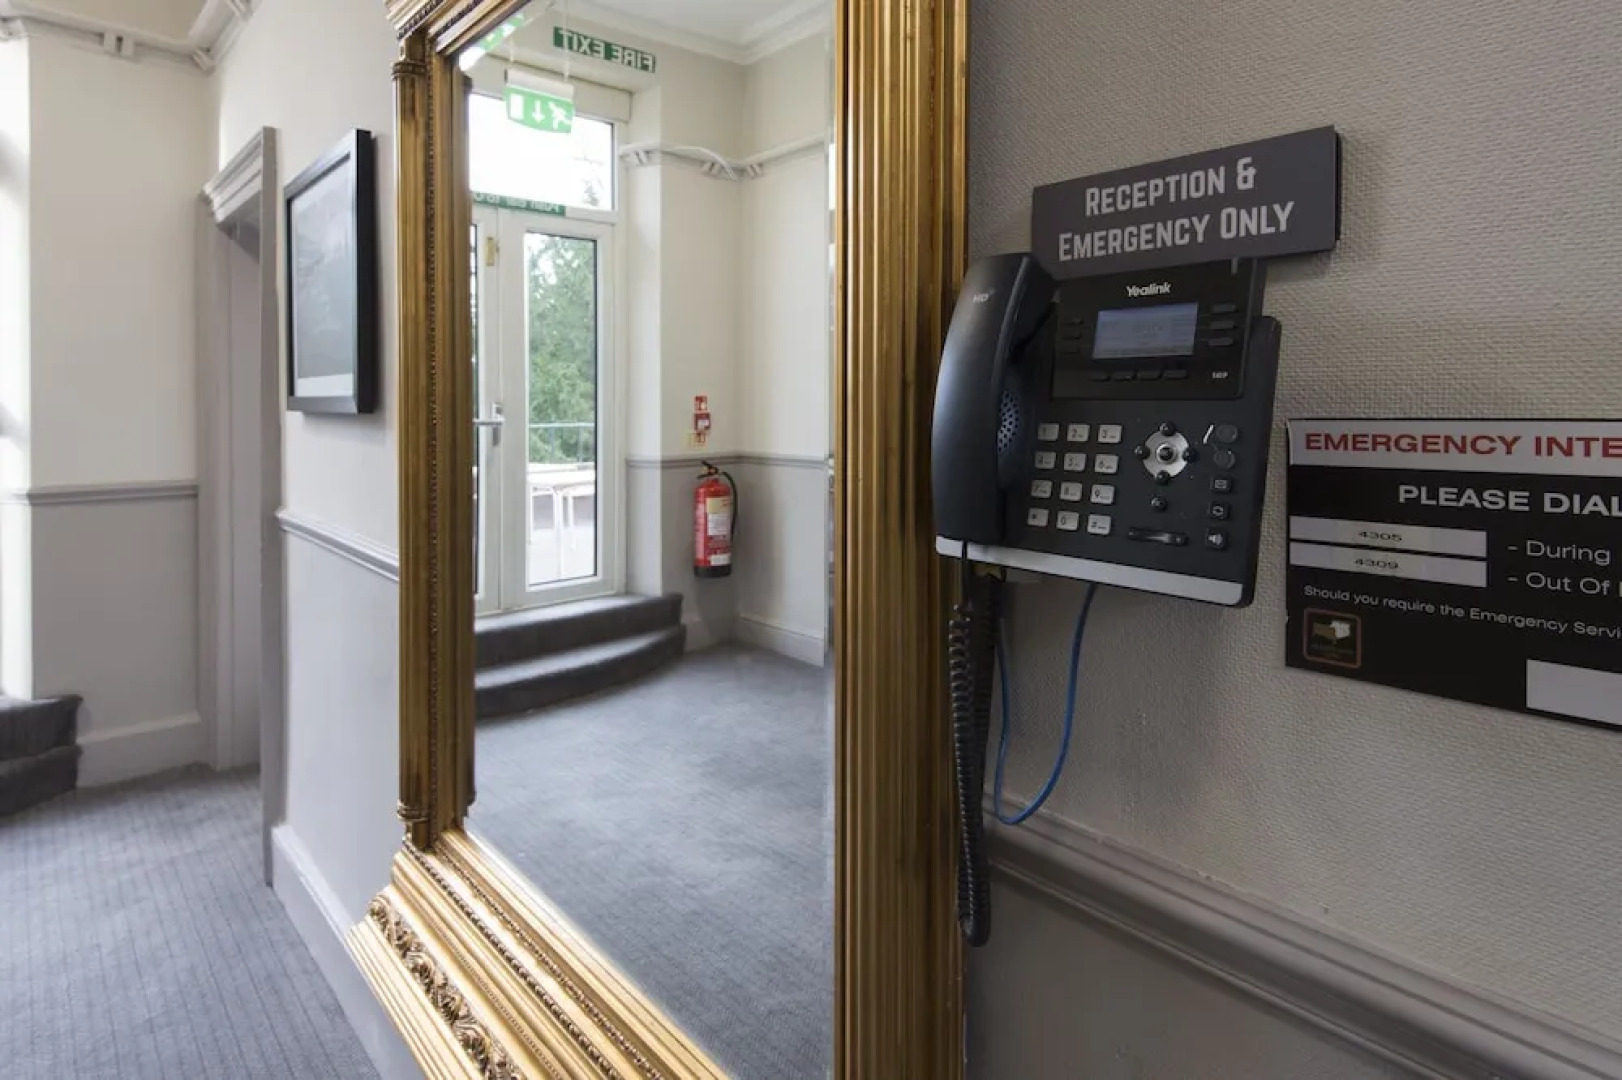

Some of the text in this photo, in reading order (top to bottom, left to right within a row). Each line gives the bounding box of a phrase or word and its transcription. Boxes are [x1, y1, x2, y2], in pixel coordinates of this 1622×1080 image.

[1085, 157, 1257, 216] RECEPTION &
[1058, 201, 1295, 262] EMERGENCY ONLY
[1126, 282, 1172, 298] Yealink
[1305, 432, 1622, 459] EMERGENCY INTE
[1398, 484, 1622, 518] PLEASE DIAL
[1358, 531, 1402, 542] 4305
[1355, 558, 1398, 570] 4309
[1526, 539, 1610, 566] During
[1526, 571, 1572, 593] Out
[1579, 577, 1611, 596] Of
[1303, 584, 1622, 639] Should you require the Emergency Servi
